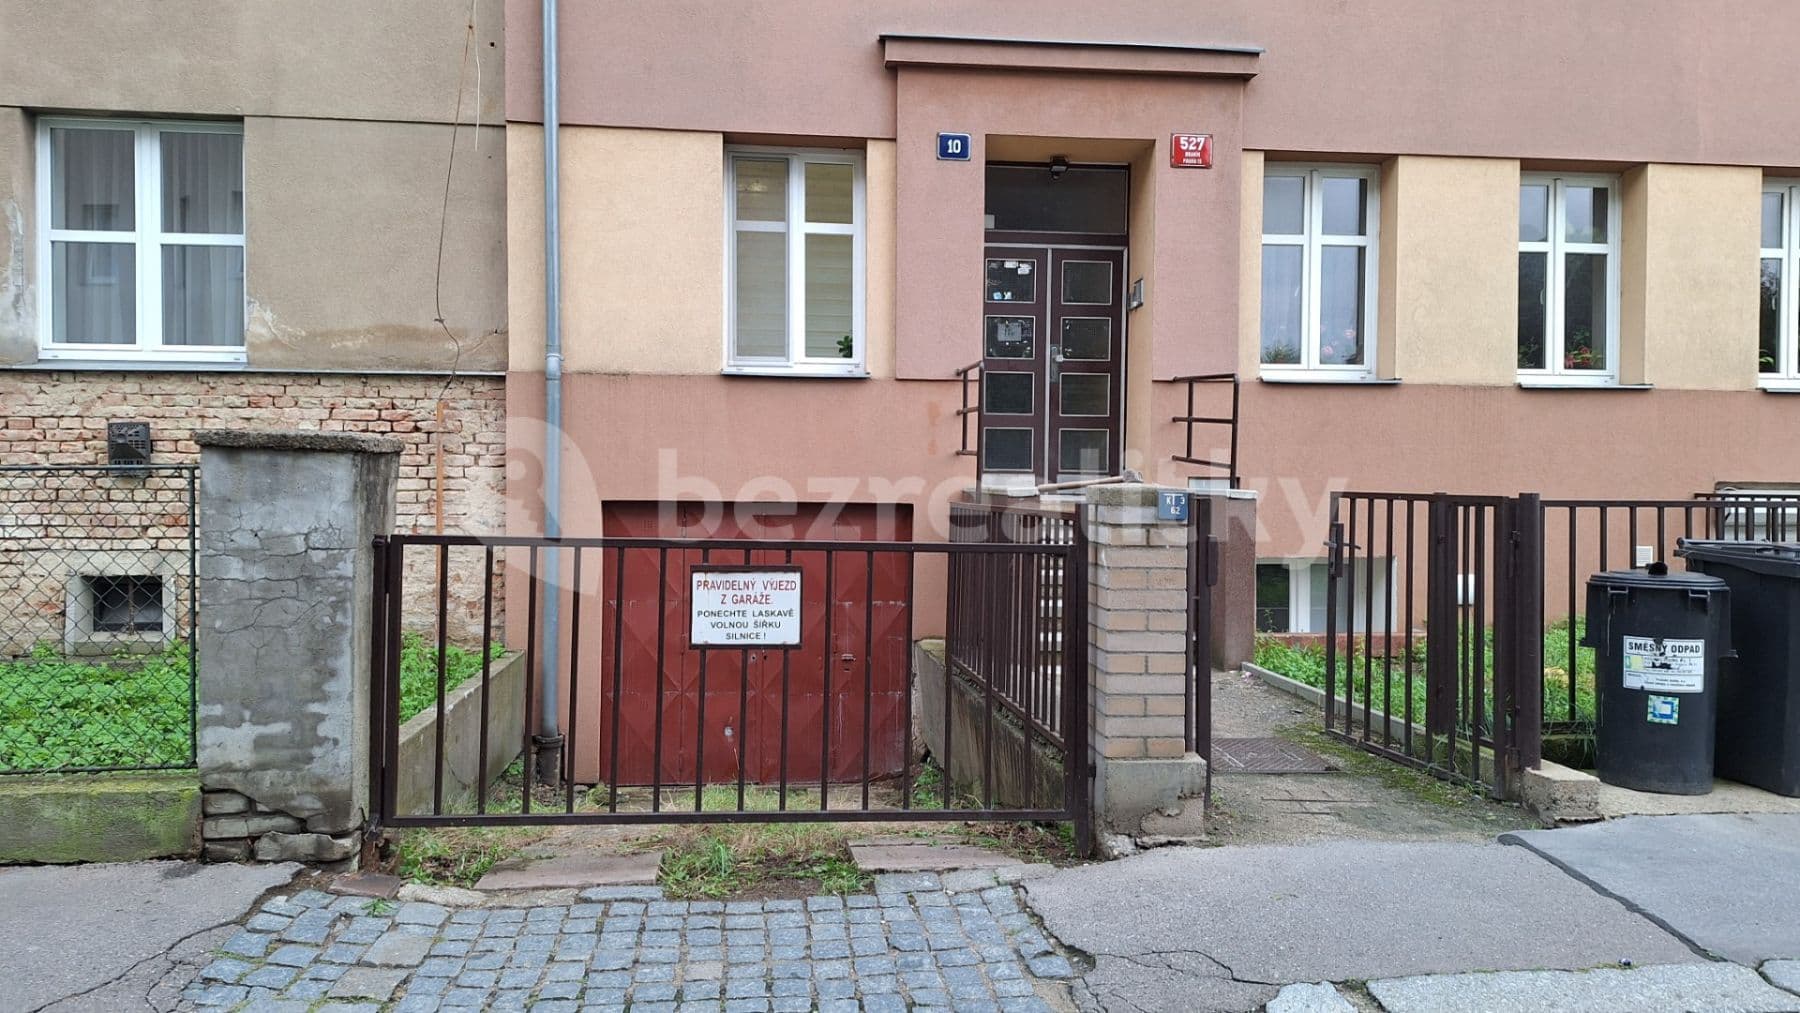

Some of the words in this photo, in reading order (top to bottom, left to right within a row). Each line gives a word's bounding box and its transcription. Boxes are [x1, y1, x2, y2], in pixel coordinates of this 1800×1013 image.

[947, 139, 961, 153] 10
[1180, 136, 1205, 150] 527
[1170, 507, 1181, 515] 62
[696, 578, 757, 591] PRAVIDELNÝ
[762, 578, 797, 591] VÝJEZD
[720, 594, 727, 605] Z
[731, 592, 771, 605] GARÁŽE
[697, 610, 748, 618] PONECHTE
[710, 621, 749, 629] VOLNOU
[725, 632, 761, 641] SILNICE
[1671, 644, 1701, 654] ODPAD
